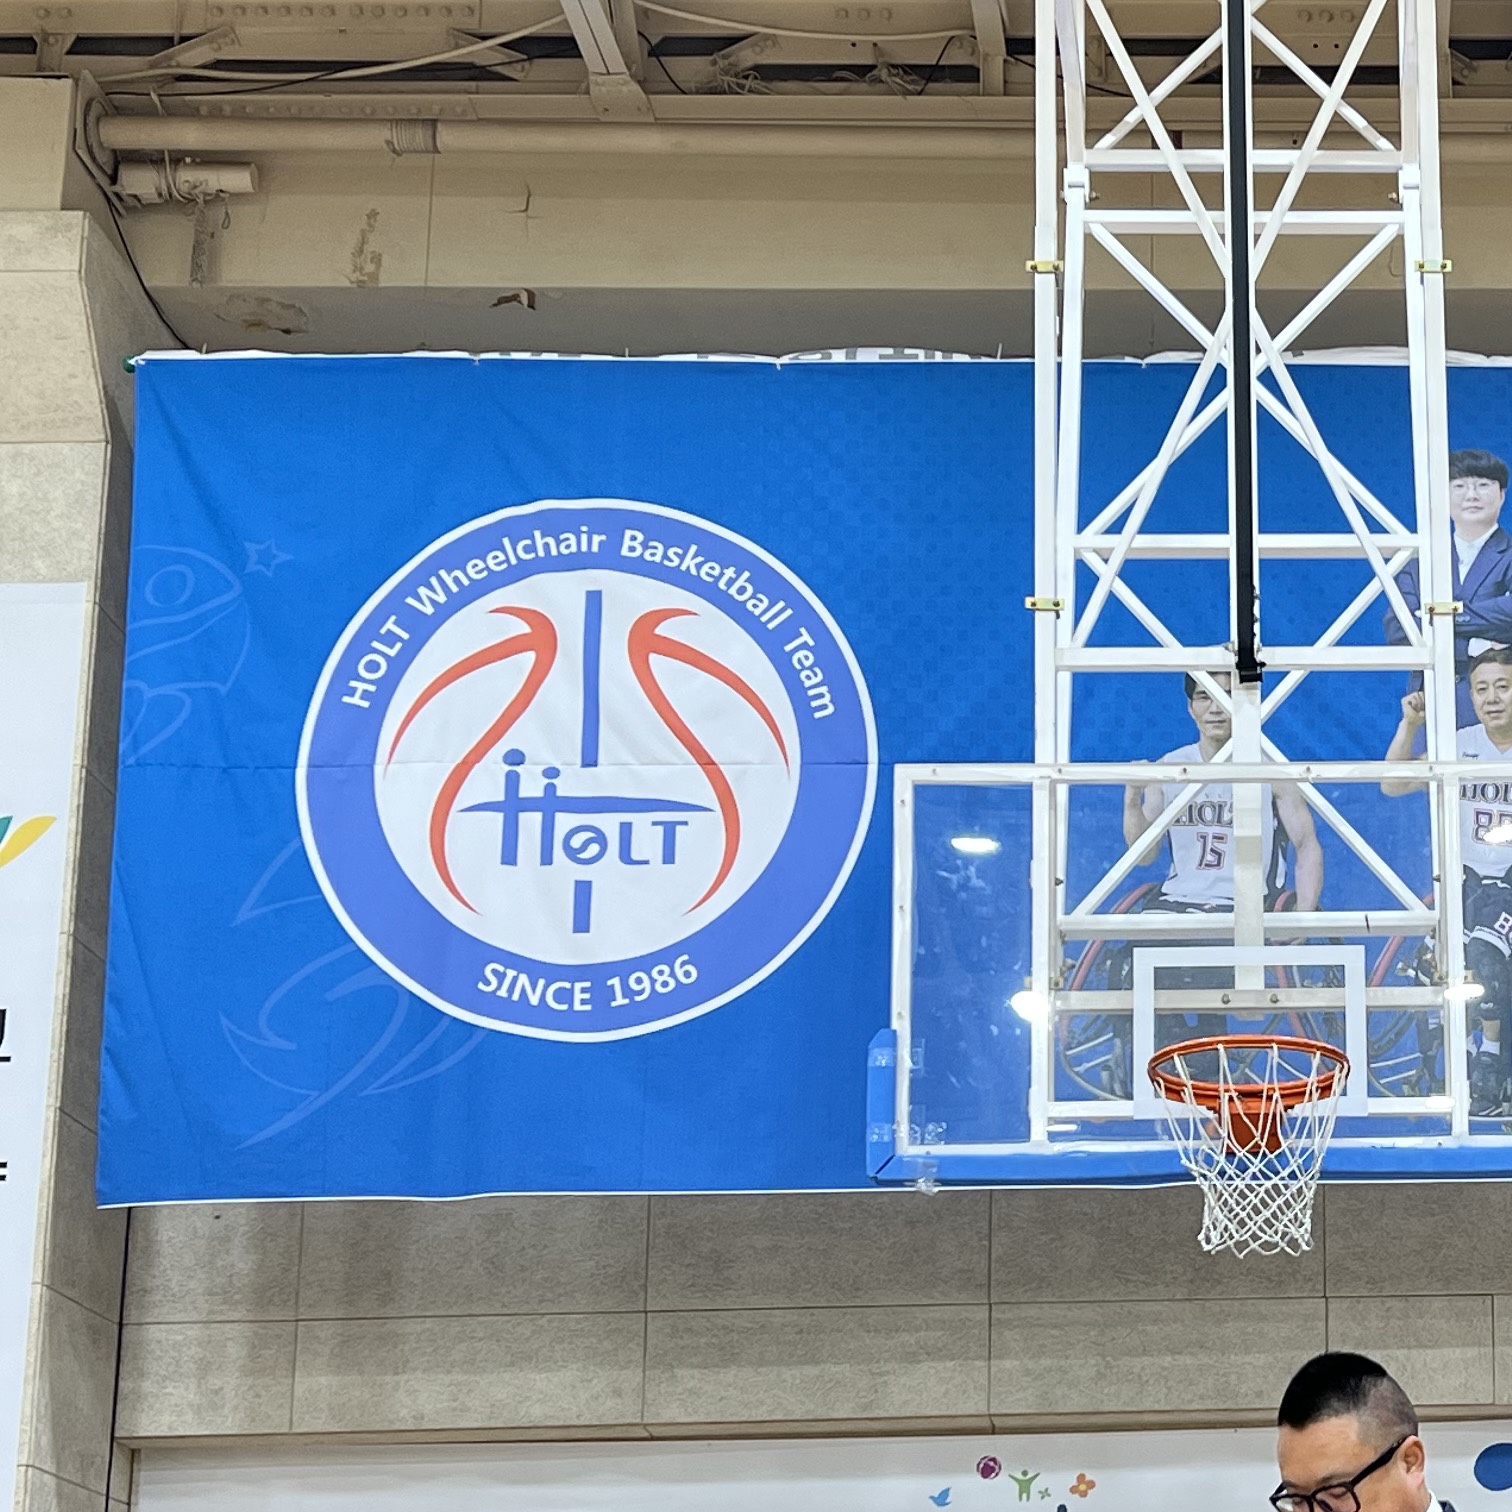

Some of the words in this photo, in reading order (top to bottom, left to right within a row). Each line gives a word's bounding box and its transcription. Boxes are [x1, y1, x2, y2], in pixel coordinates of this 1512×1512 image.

[342, 614, 410, 709] HOLT
[404, 526, 607, 617] Wheelchair
[621, 528, 792, 631] Basketball
[782, 628, 836, 720] Team
[480, 748, 700, 867] HOLT
[1196, 832, 1228, 870] 15
[477, 962, 592, 1012] SINCE
[607, 954, 699, 1008] 1986
